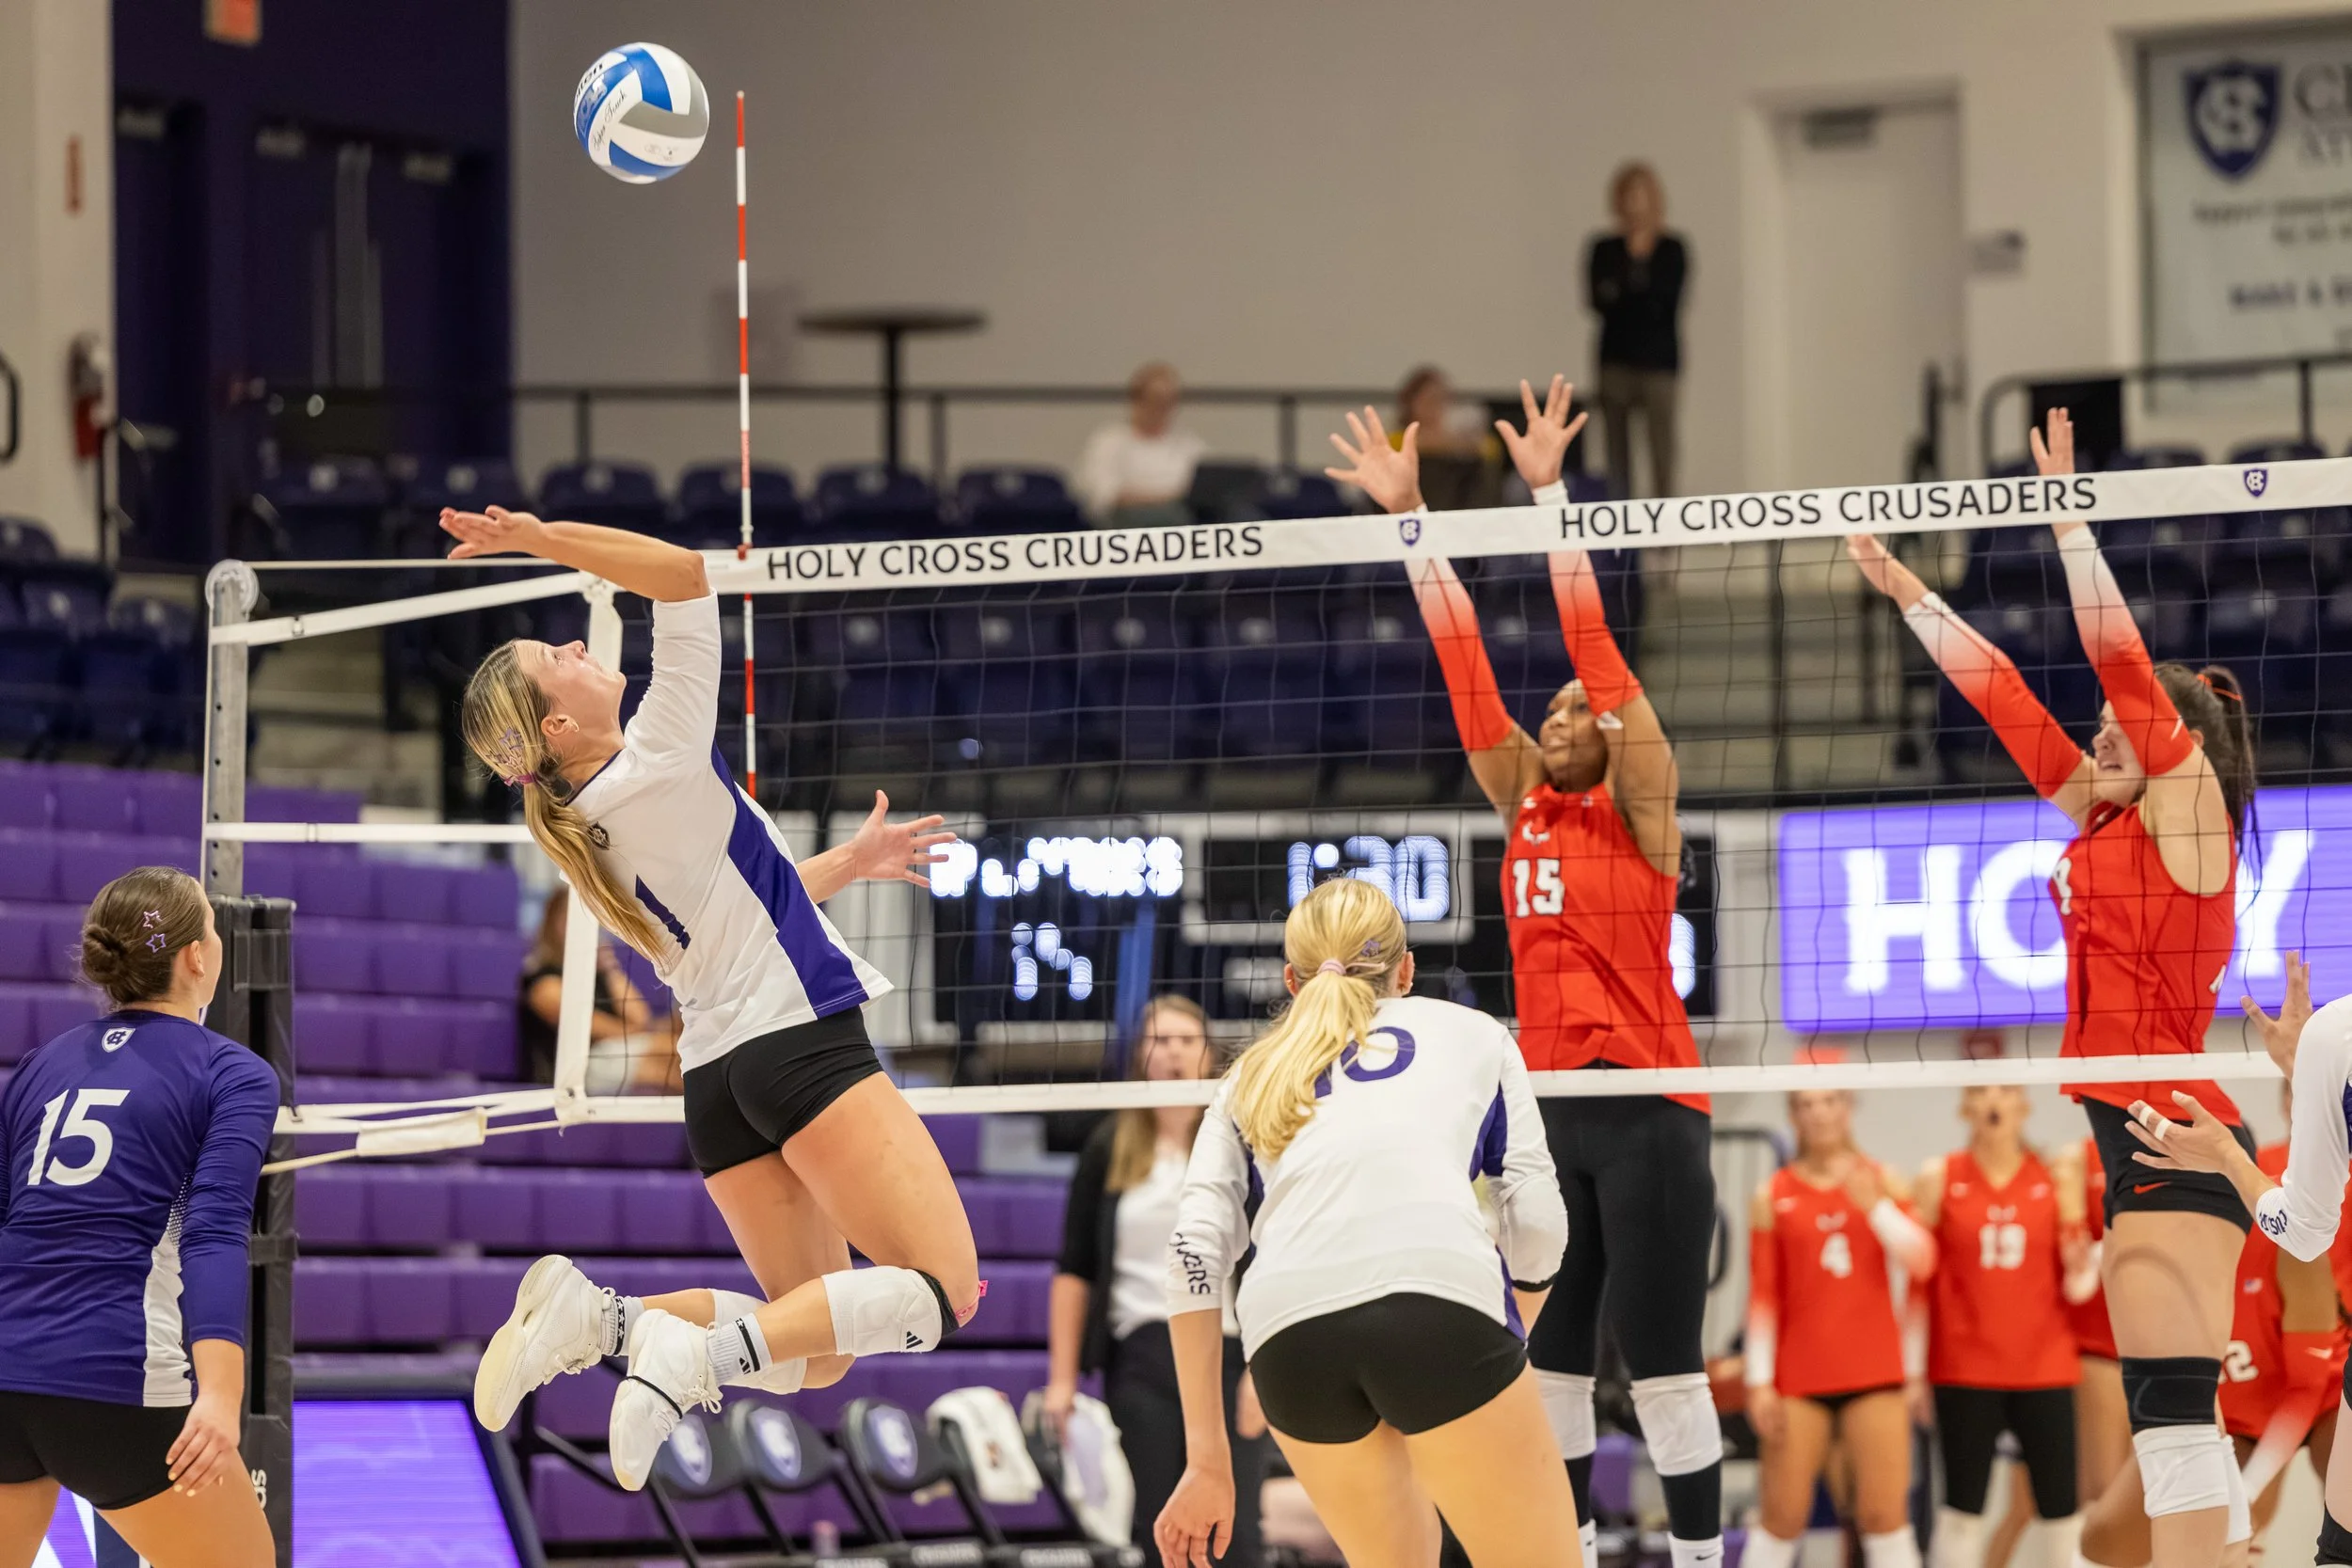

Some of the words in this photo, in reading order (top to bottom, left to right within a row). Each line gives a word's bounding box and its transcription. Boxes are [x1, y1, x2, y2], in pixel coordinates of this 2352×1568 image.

[1561, 502, 1665, 540] HOLY
[1679, 493, 1821, 532] CROSS
[1839, 477, 2097, 523] CRUSADERS
[767, 546, 867, 580] HOLY
[879, 538, 1010, 577] CROSS
[1025, 526, 1263, 569] CRUSADERS
[1512, 857, 1566, 919] 15
[1843, 829, 2317, 995] HOY
[26, 1088, 131, 1186] 15
[1820, 1232, 1853, 1279] 4
